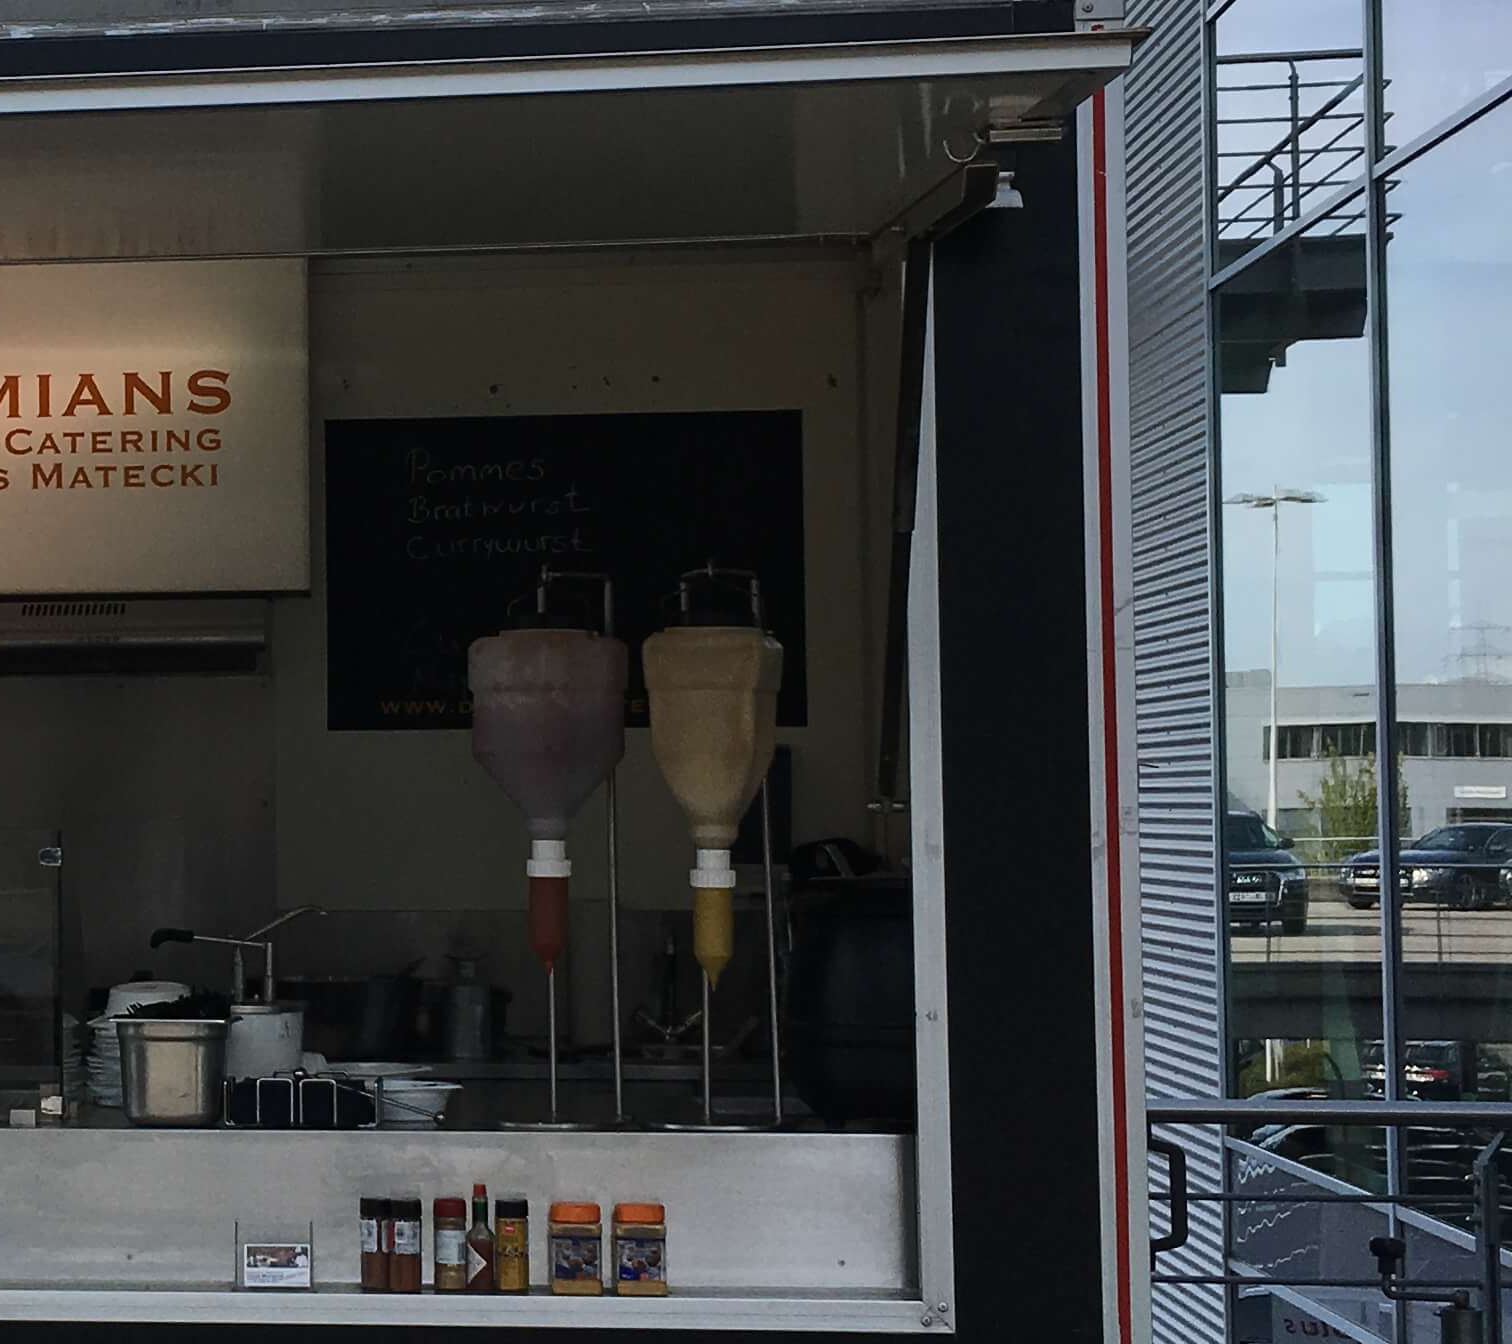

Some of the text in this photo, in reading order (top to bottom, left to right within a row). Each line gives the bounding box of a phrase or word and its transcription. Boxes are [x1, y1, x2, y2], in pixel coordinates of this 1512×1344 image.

[32, 462, 220, 490] MATECKI
[406, 448, 545, 487] Pommes
[407, 482, 591, 525] Bratwurst
